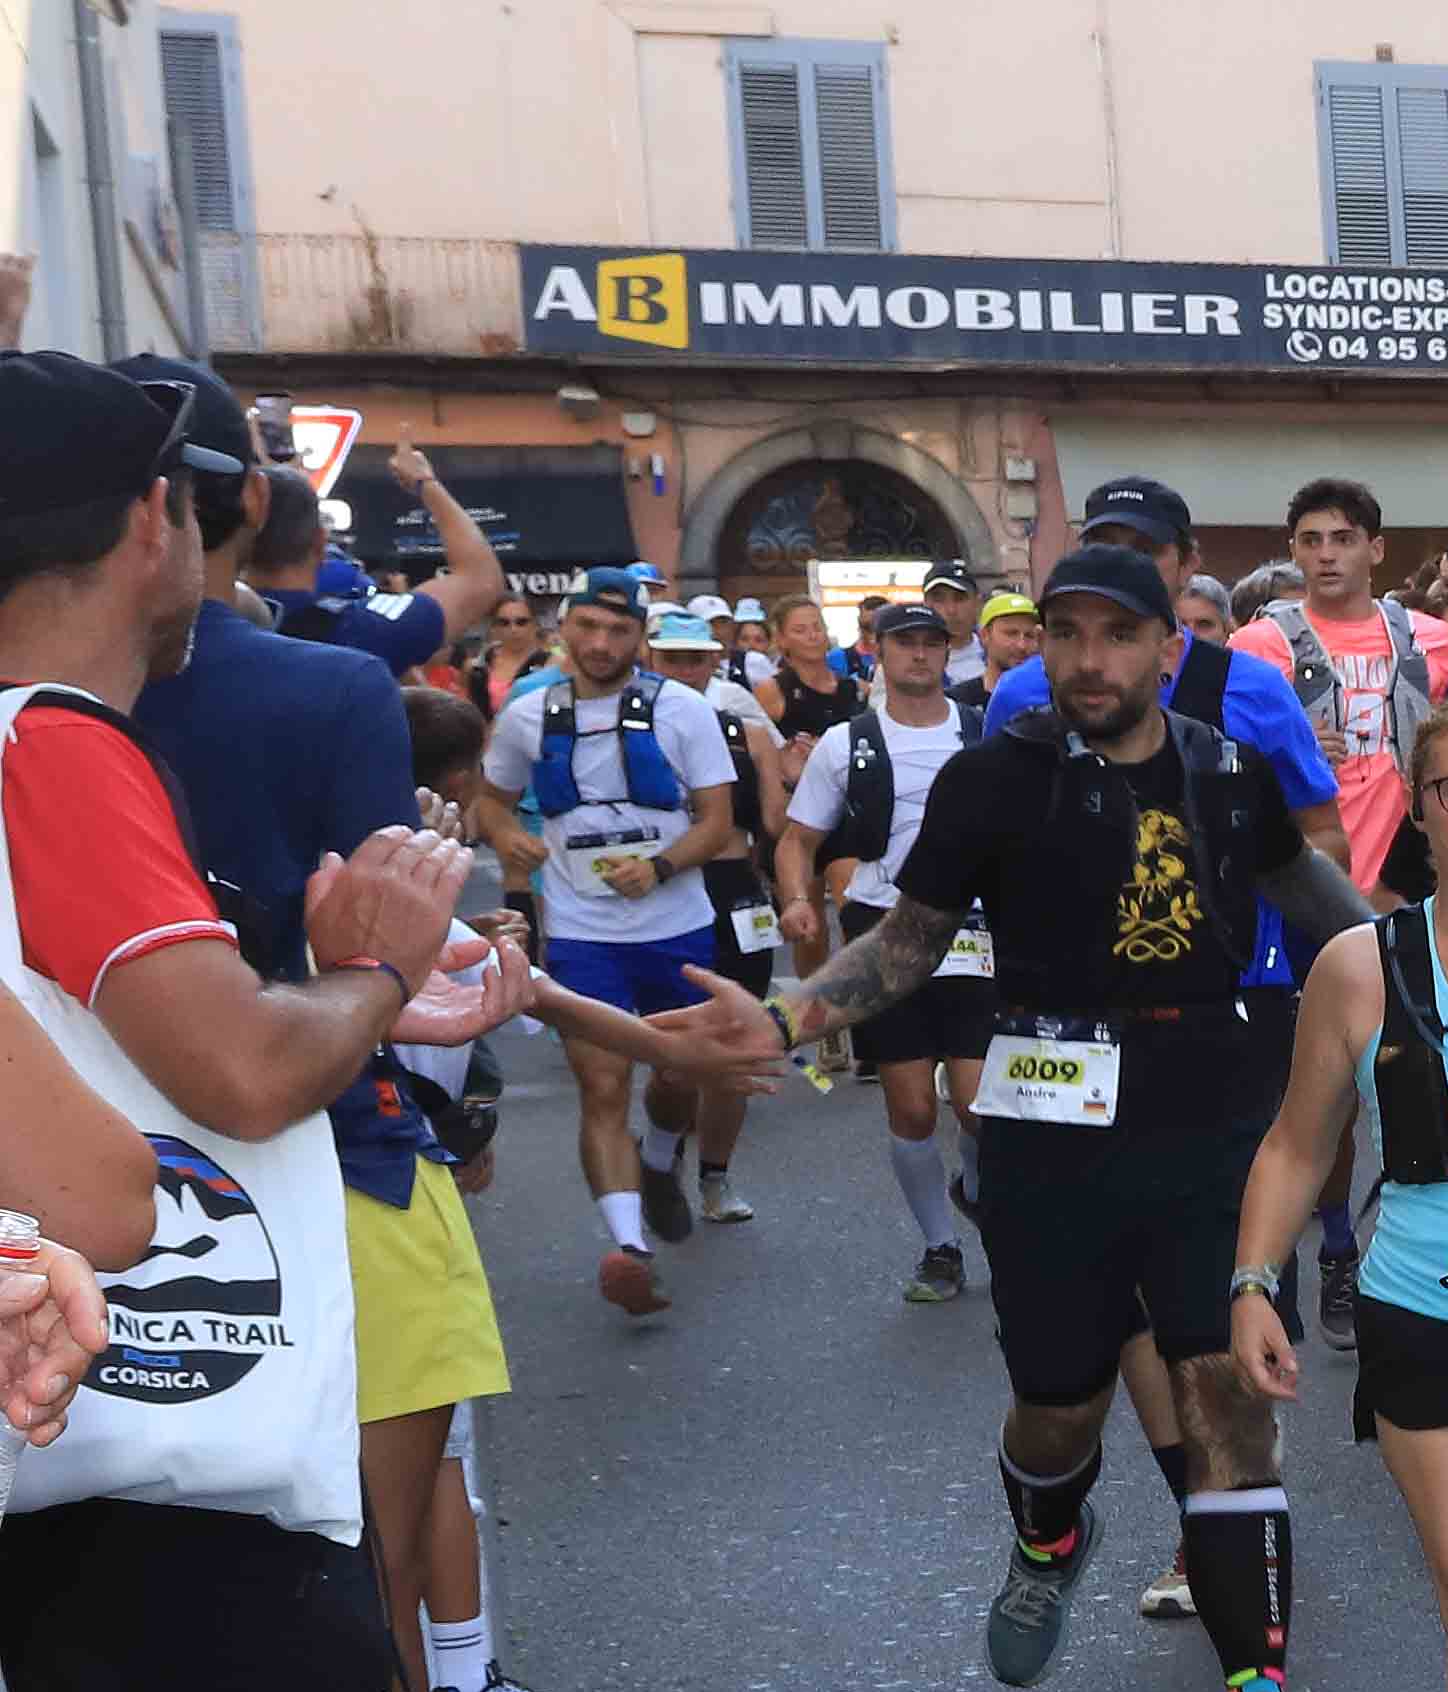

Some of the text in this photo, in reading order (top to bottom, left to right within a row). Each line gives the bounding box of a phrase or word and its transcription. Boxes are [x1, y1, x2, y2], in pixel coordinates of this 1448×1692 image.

[701, 283, 1240, 336] IMMOBILIER
[1328, 336, 1369, 360] 04
[1378, 337, 1418, 361] 95
[1009, 1057, 1078, 1082] 6009
[113, 1313, 294, 1347] NICA TRAIL
[99, 1366, 210, 1389] CORSICA
